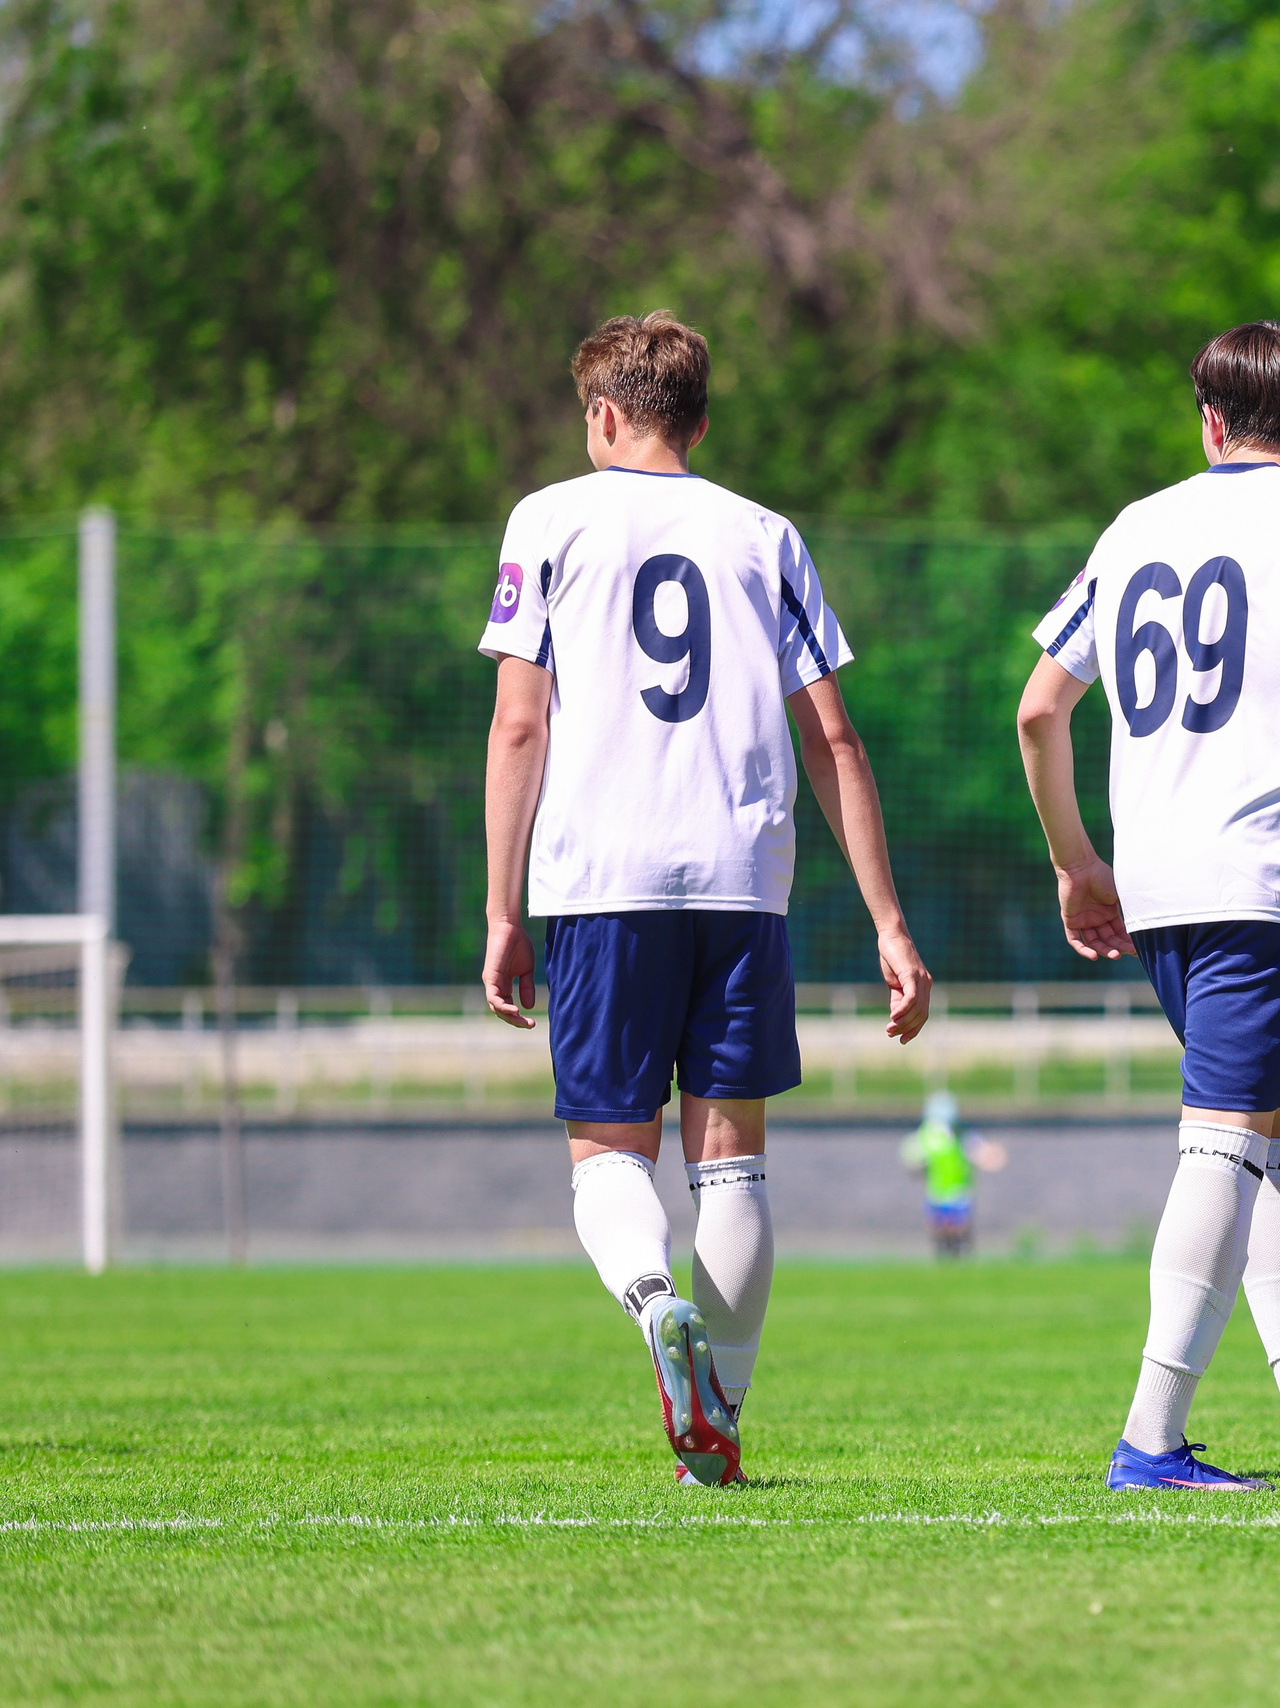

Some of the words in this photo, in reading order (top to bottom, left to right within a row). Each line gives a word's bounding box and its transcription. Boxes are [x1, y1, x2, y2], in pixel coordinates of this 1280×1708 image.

[632, 554, 712, 723] 9
[1115, 556, 1248, 737] 69
[696, 1173, 760, 1189] KELME
[1181, 1146, 1242, 1165] KELME
